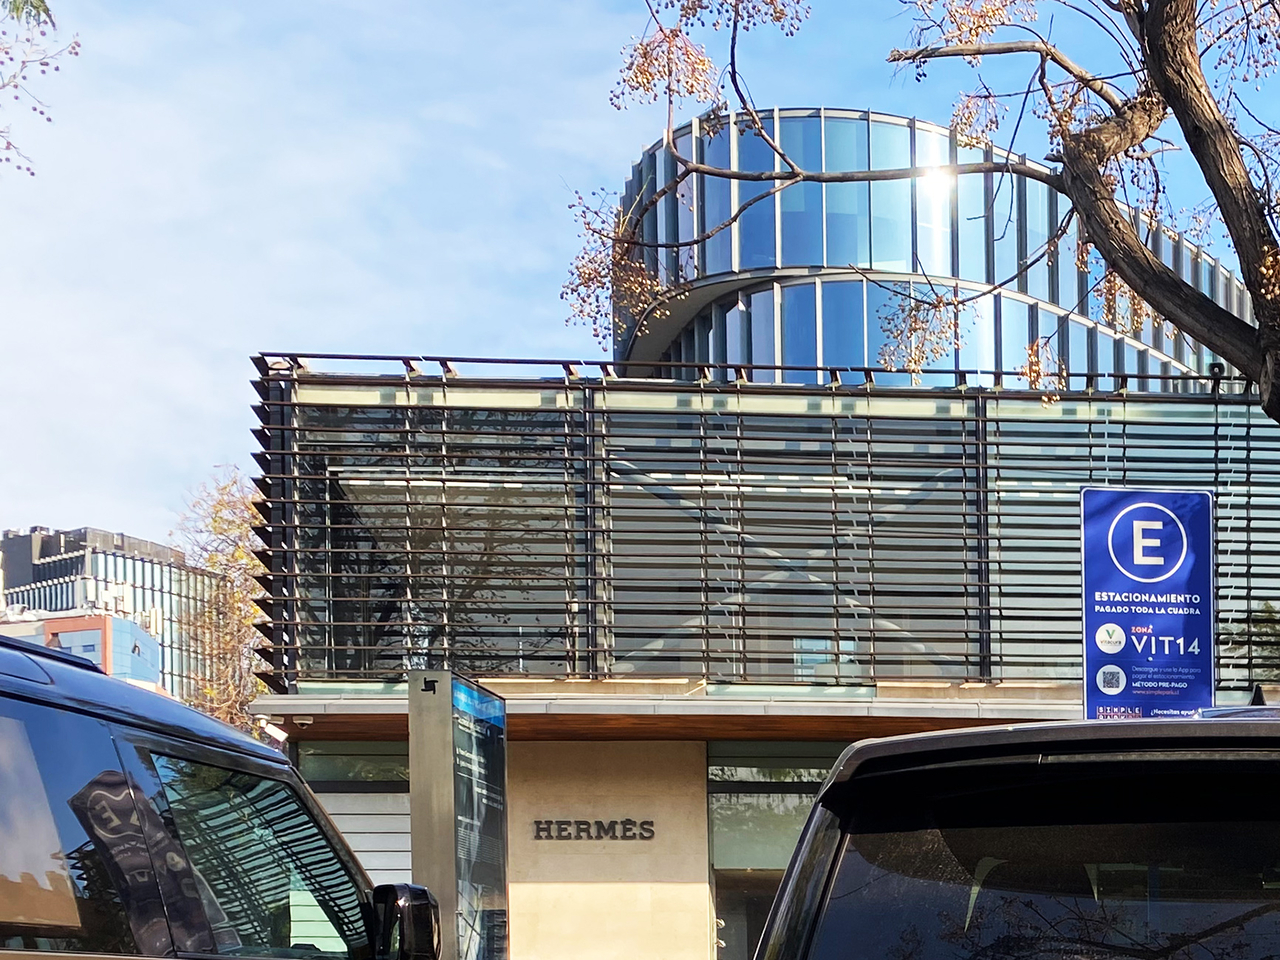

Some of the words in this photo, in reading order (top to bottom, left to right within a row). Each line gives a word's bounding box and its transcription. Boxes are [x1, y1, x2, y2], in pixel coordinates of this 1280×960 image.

[1132, 520, 1165, 565] E
[1094, 591, 1201, 604] ESTACIONAMIENTO
[1094, 605, 1129, 614] PAGADO
[1130, 606, 1154, 614] TODA
[1155, 606, 1166, 615] LA
[1167, 607, 1201, 615] CUADRA
[1131, 626, 1153, 634] ZONA
[1130, 635, 1201, 655] VIT14
[533, 818, 655, 841] HERMÈS
